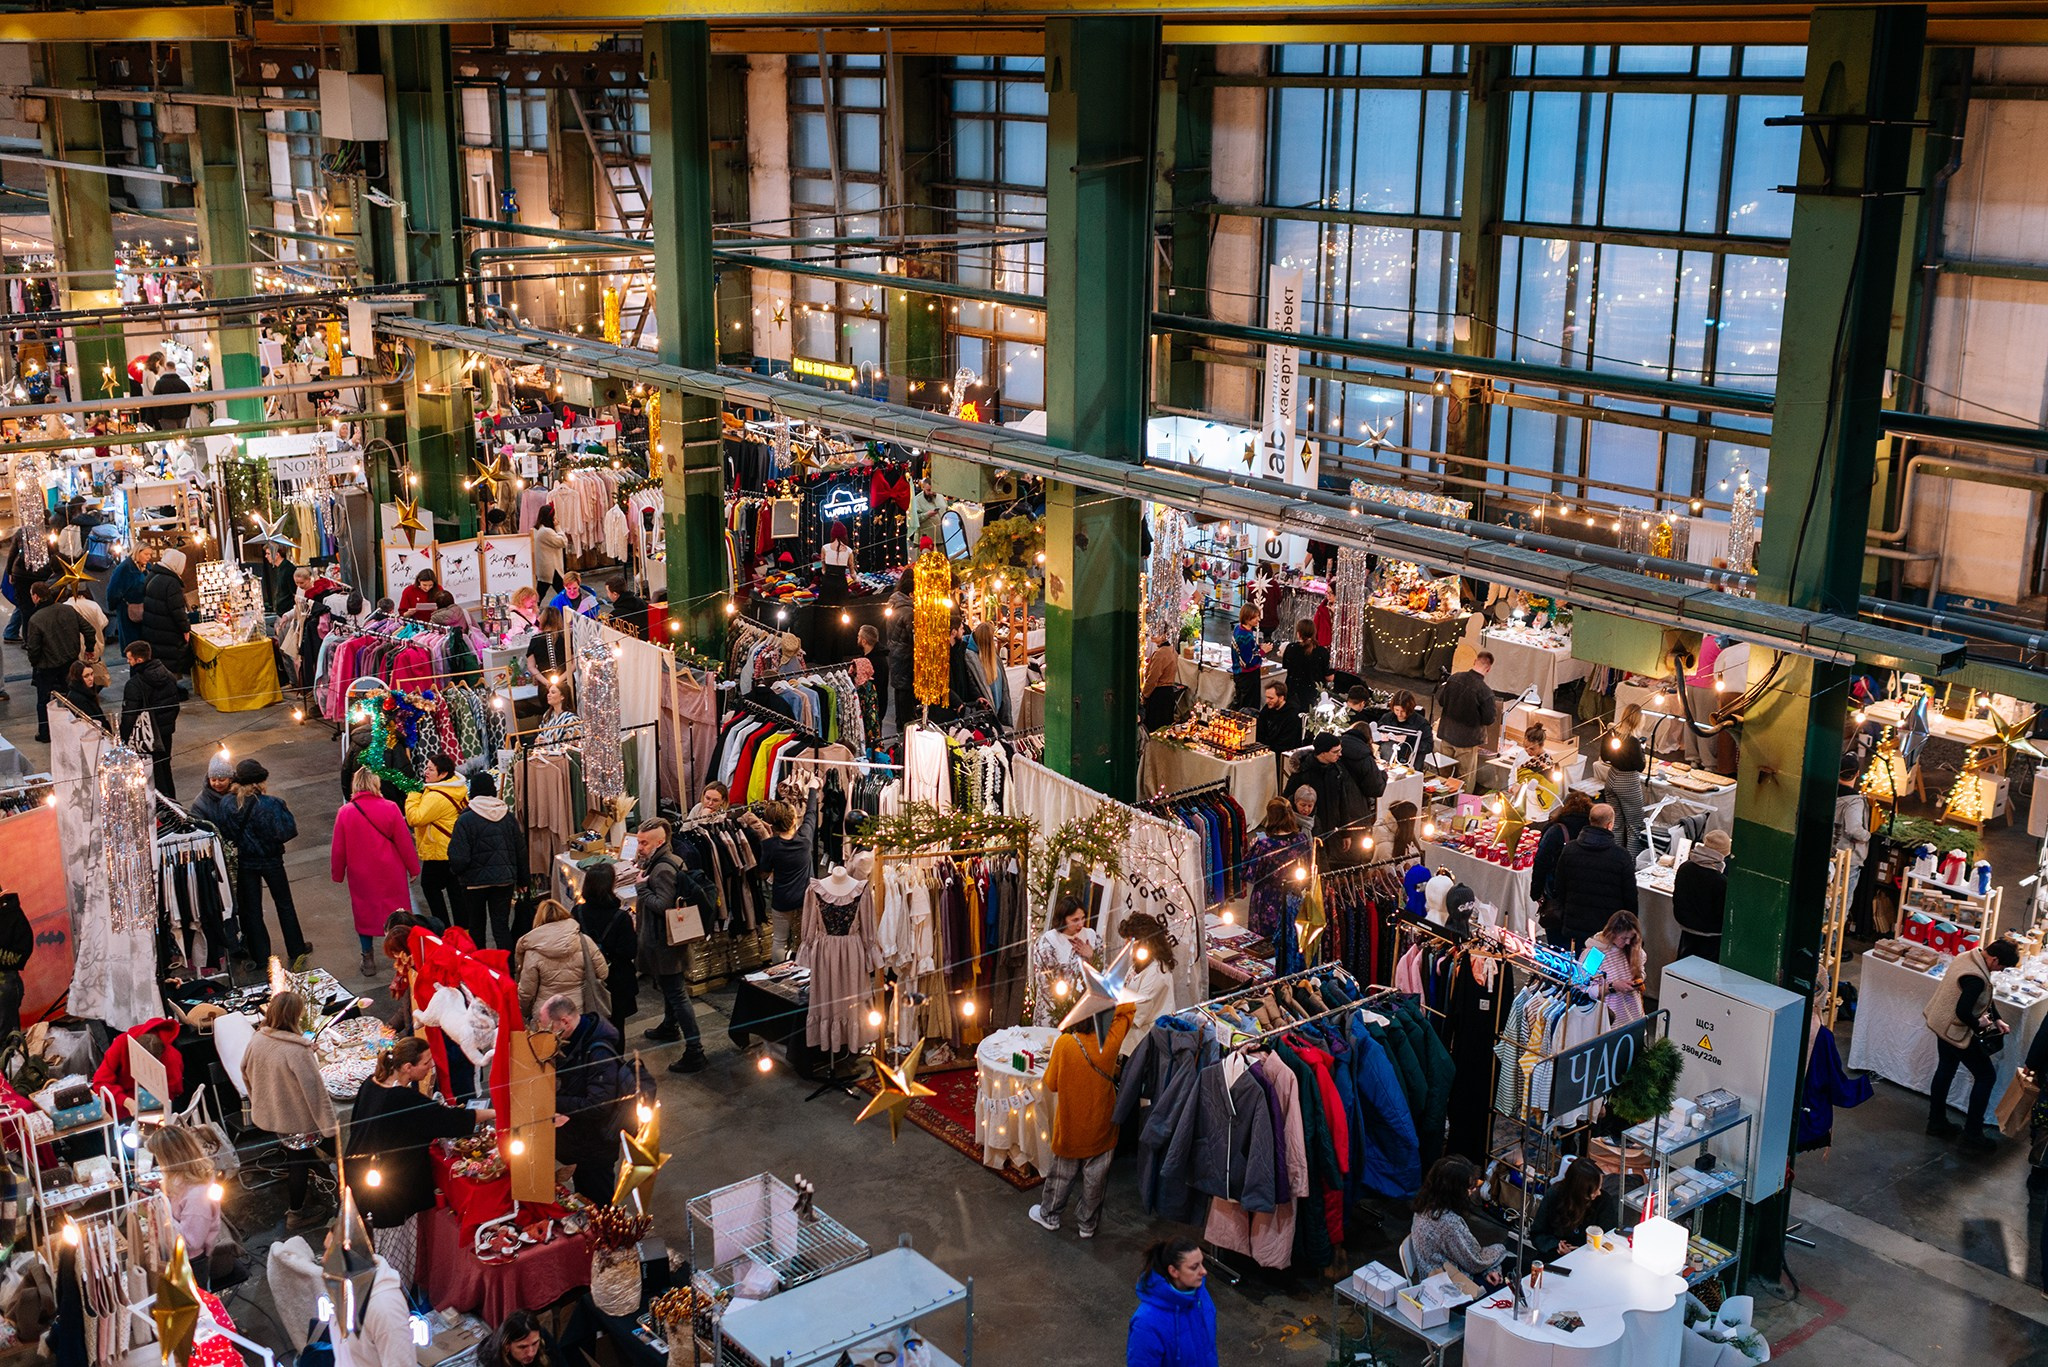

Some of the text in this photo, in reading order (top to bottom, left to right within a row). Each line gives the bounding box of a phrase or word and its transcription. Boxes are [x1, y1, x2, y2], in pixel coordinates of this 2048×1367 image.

[1281, 286, 1294, 384] арт-бъект
[506, 415, 538, 426] MOOD
[1569, 1033, 1635, 1105] ЧАО
